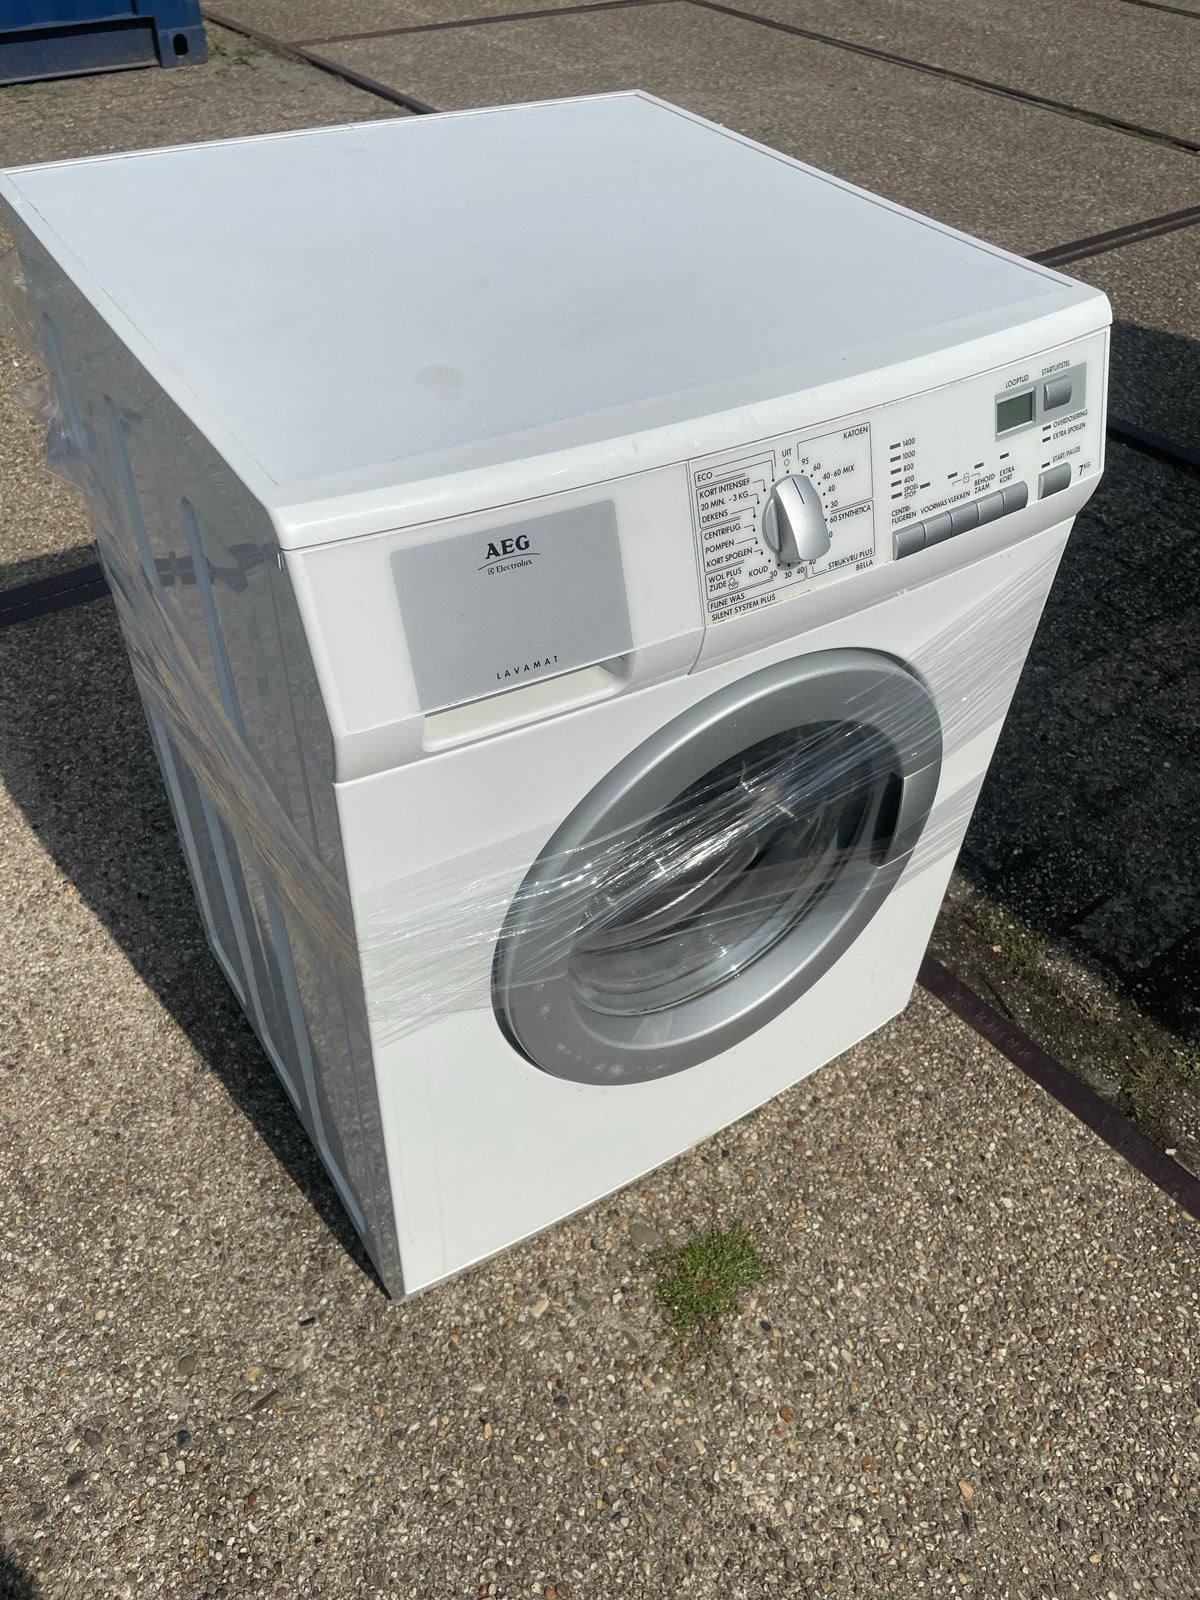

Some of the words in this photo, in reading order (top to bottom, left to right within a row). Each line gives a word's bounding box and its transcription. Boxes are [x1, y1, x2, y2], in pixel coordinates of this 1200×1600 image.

[1053, 409, 1088, 428] OVERDOSERING
[843, 426, 869, 439] KATOEN
[1052, 430, 1067, 440] EXTRA
[1068, 422, 1086, 434] SPOELEN
[902, 438, 916, 447] 1400
[782, 448, 792, 458] UIT
[802, 457, 809, 465] 95
[813, 462, 821, 471] 60
[903, 463, 915, 472] 800
[842, 464, 855, 474] MIX
[1000, 466, 1015, 477] EXTRA
[698, 472, 713, 482] ECO
[904, 475, 915, 484] 400
[974, 473, 996, 487] BEHOED-
[1000, 474, 1013, 484] KORT
[700, 488, 717, 499] KORT
[719, 478, 750, 493] INTENSIEF
[828, 484, 836, 493] 40
[904, 490, 917, 500] STOP
[974, 482, 990, 495] ZAAM
[701, 503, 710, 511] 20
[710, 498, 726, 508] MIN.
[738, 490, 749, 500] KG
[830, 500, 839, 509] 30
[920, 498, 948, 514] VOORWAS
[948, 490, 971, 504] VLEKKEN
[702, 509, 729, 523] DEKENS
[830, 515, 838, 523] 60
[838, 504, 872, 521] SYNTHETICA
[892, 504, 912, 517] CENTRI-
[892, 510, 917, 525] FUGEREN
[704, 523, 743, 541] CENTRIFUG.
[485, 534, 530, 560] AEG
[706, 539, 735, 554] POMPEN
[706, 556, 724, 568] KORT
[724, 548, 753, 562] SPOELEN
[859, 548, 873, 559] PLUS
[496, 559, 533, 573] Electrolux
[748, 566, 769, 578] KOUD
[796, 566, 805, 575] 40
[856, 560, 874, 571] BELLA
[708, 574, 725, 584] WOL
[726, 567, 742, 579] PLUS
[784, 570, 793, 579] 30
[729, 592, 745, 603] WAS
[712, 608, 733, 621] SILENT
[734, 601, 759, 614] SYSTEM
[760, 594, 776, 605] PLUS
[496, 655, 558, 680] LAVAMAT
